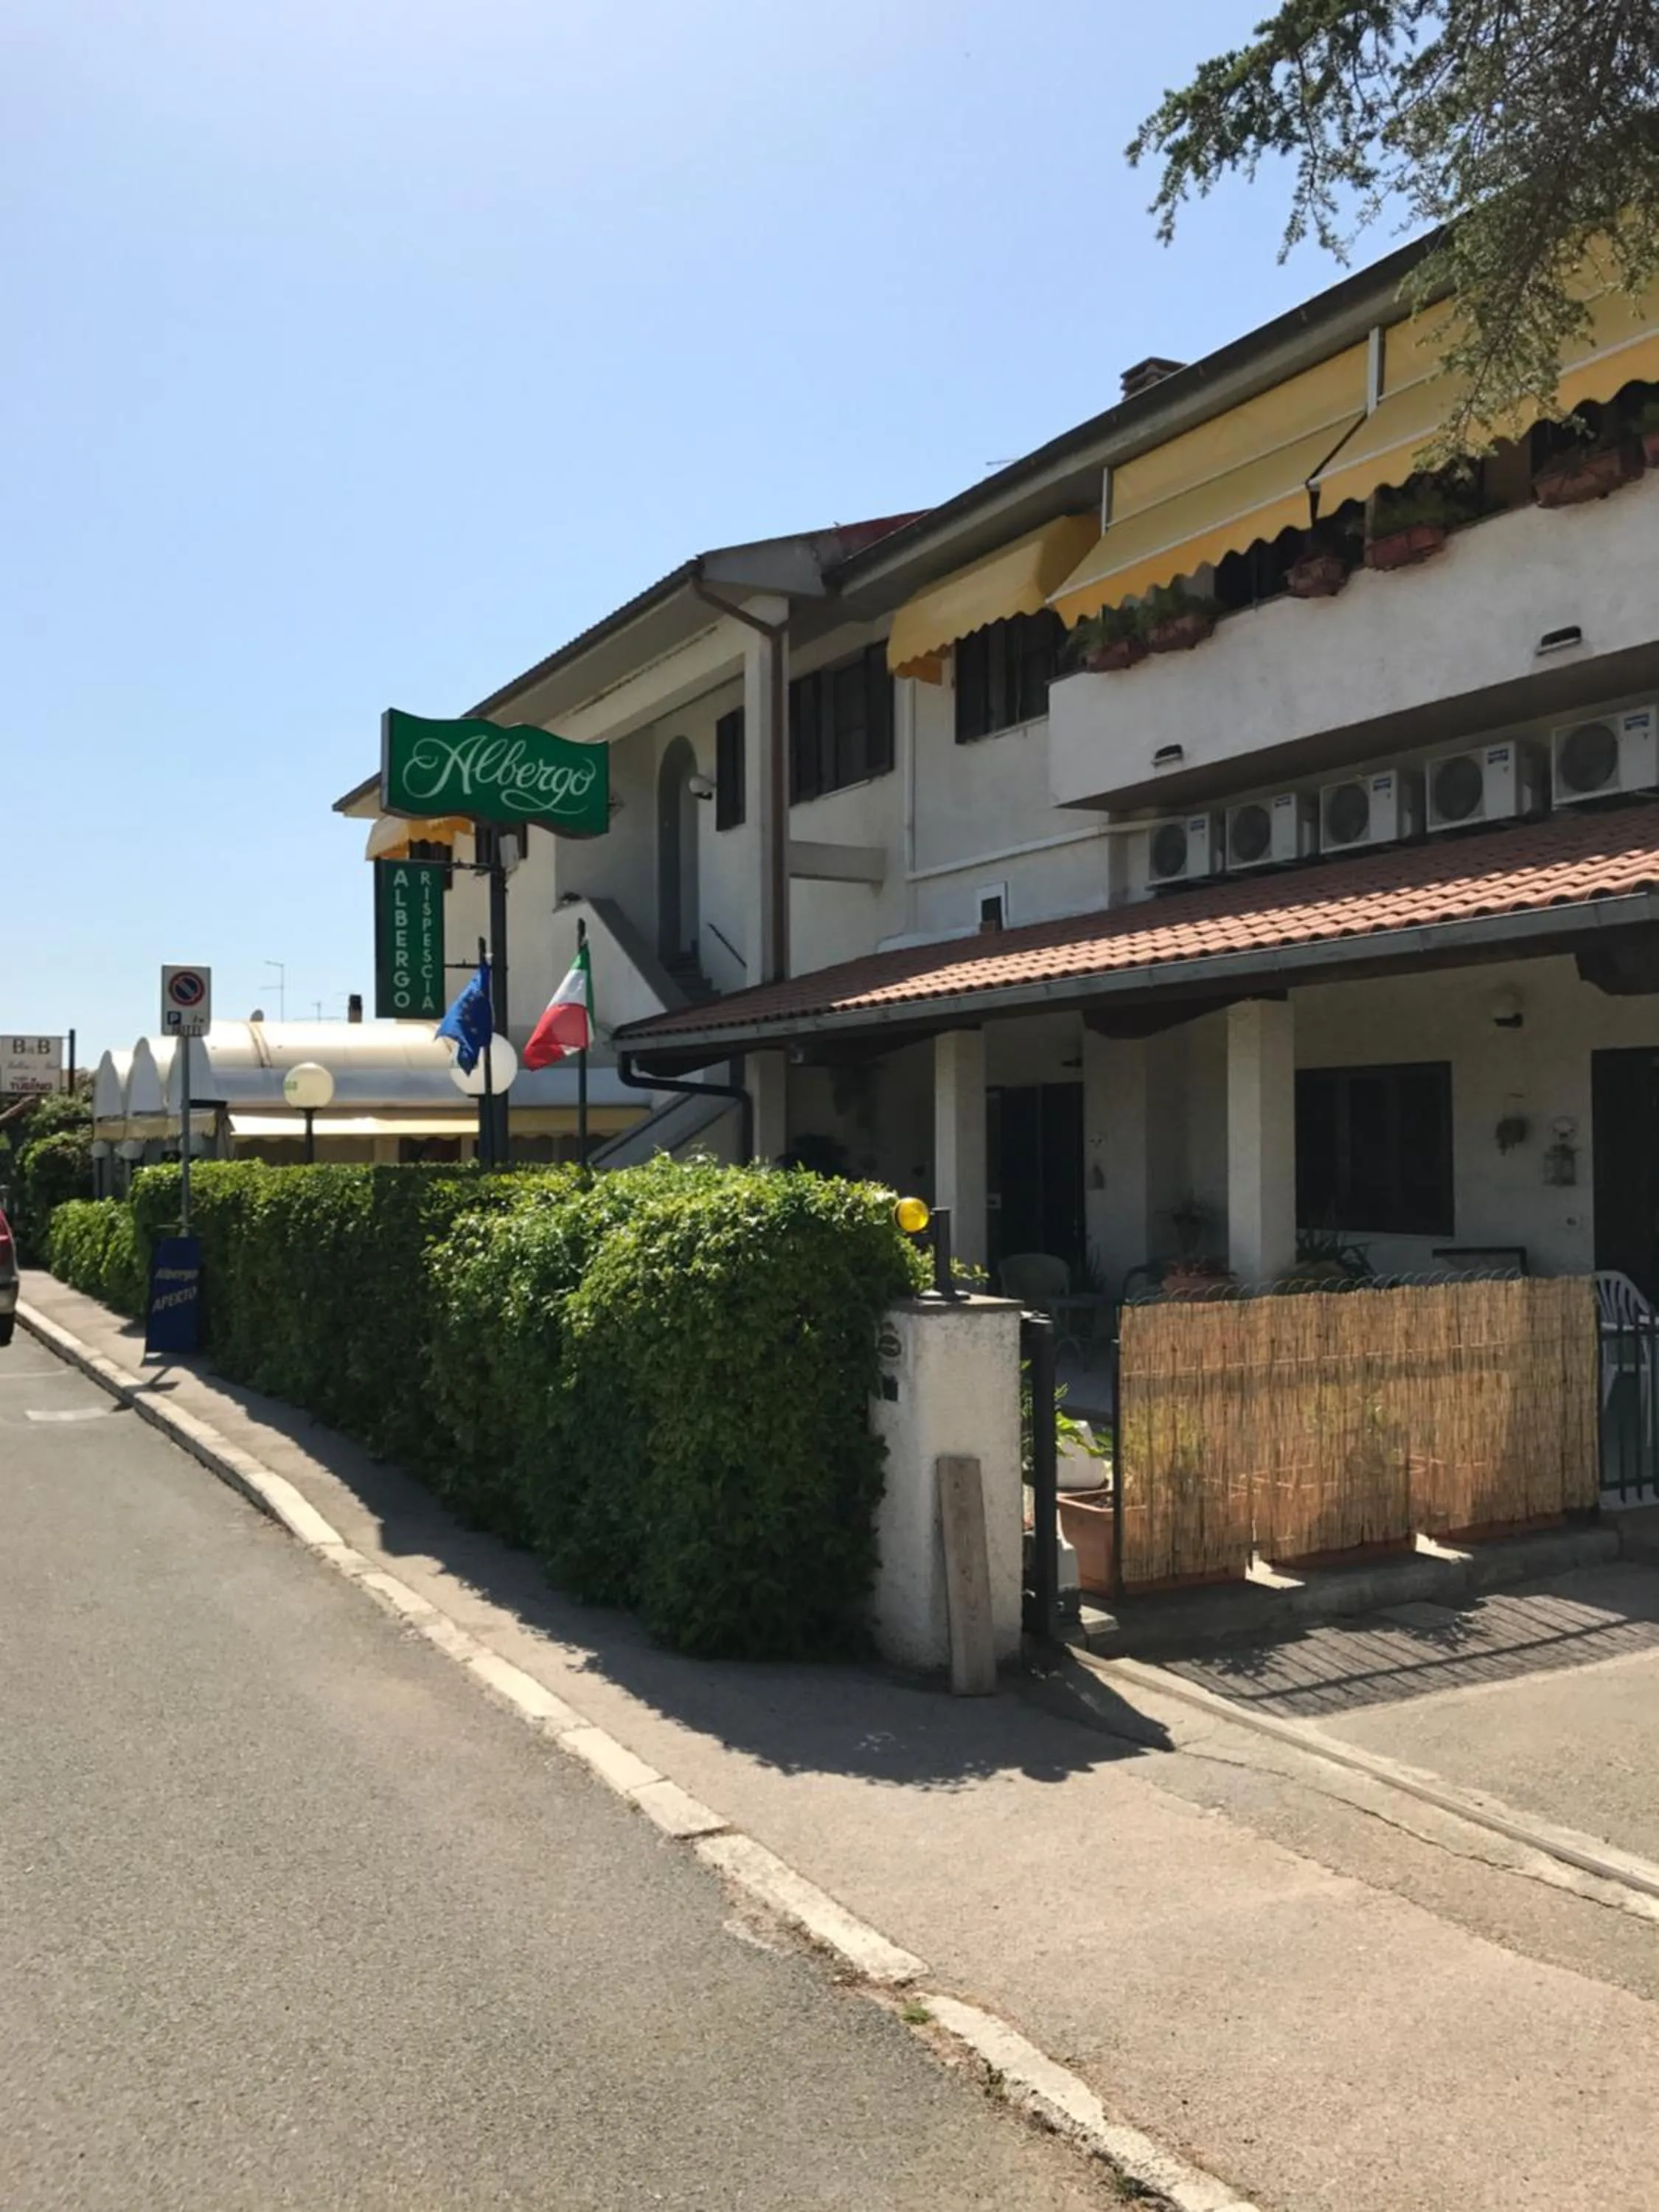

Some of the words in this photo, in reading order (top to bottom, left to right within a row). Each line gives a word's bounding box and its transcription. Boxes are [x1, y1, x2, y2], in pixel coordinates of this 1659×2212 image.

[403, 735, 596, 814] Albergo
[393, 869, 411, 1008] ALBERGO
[420, 871, 434, 1010] RISPESCIA
